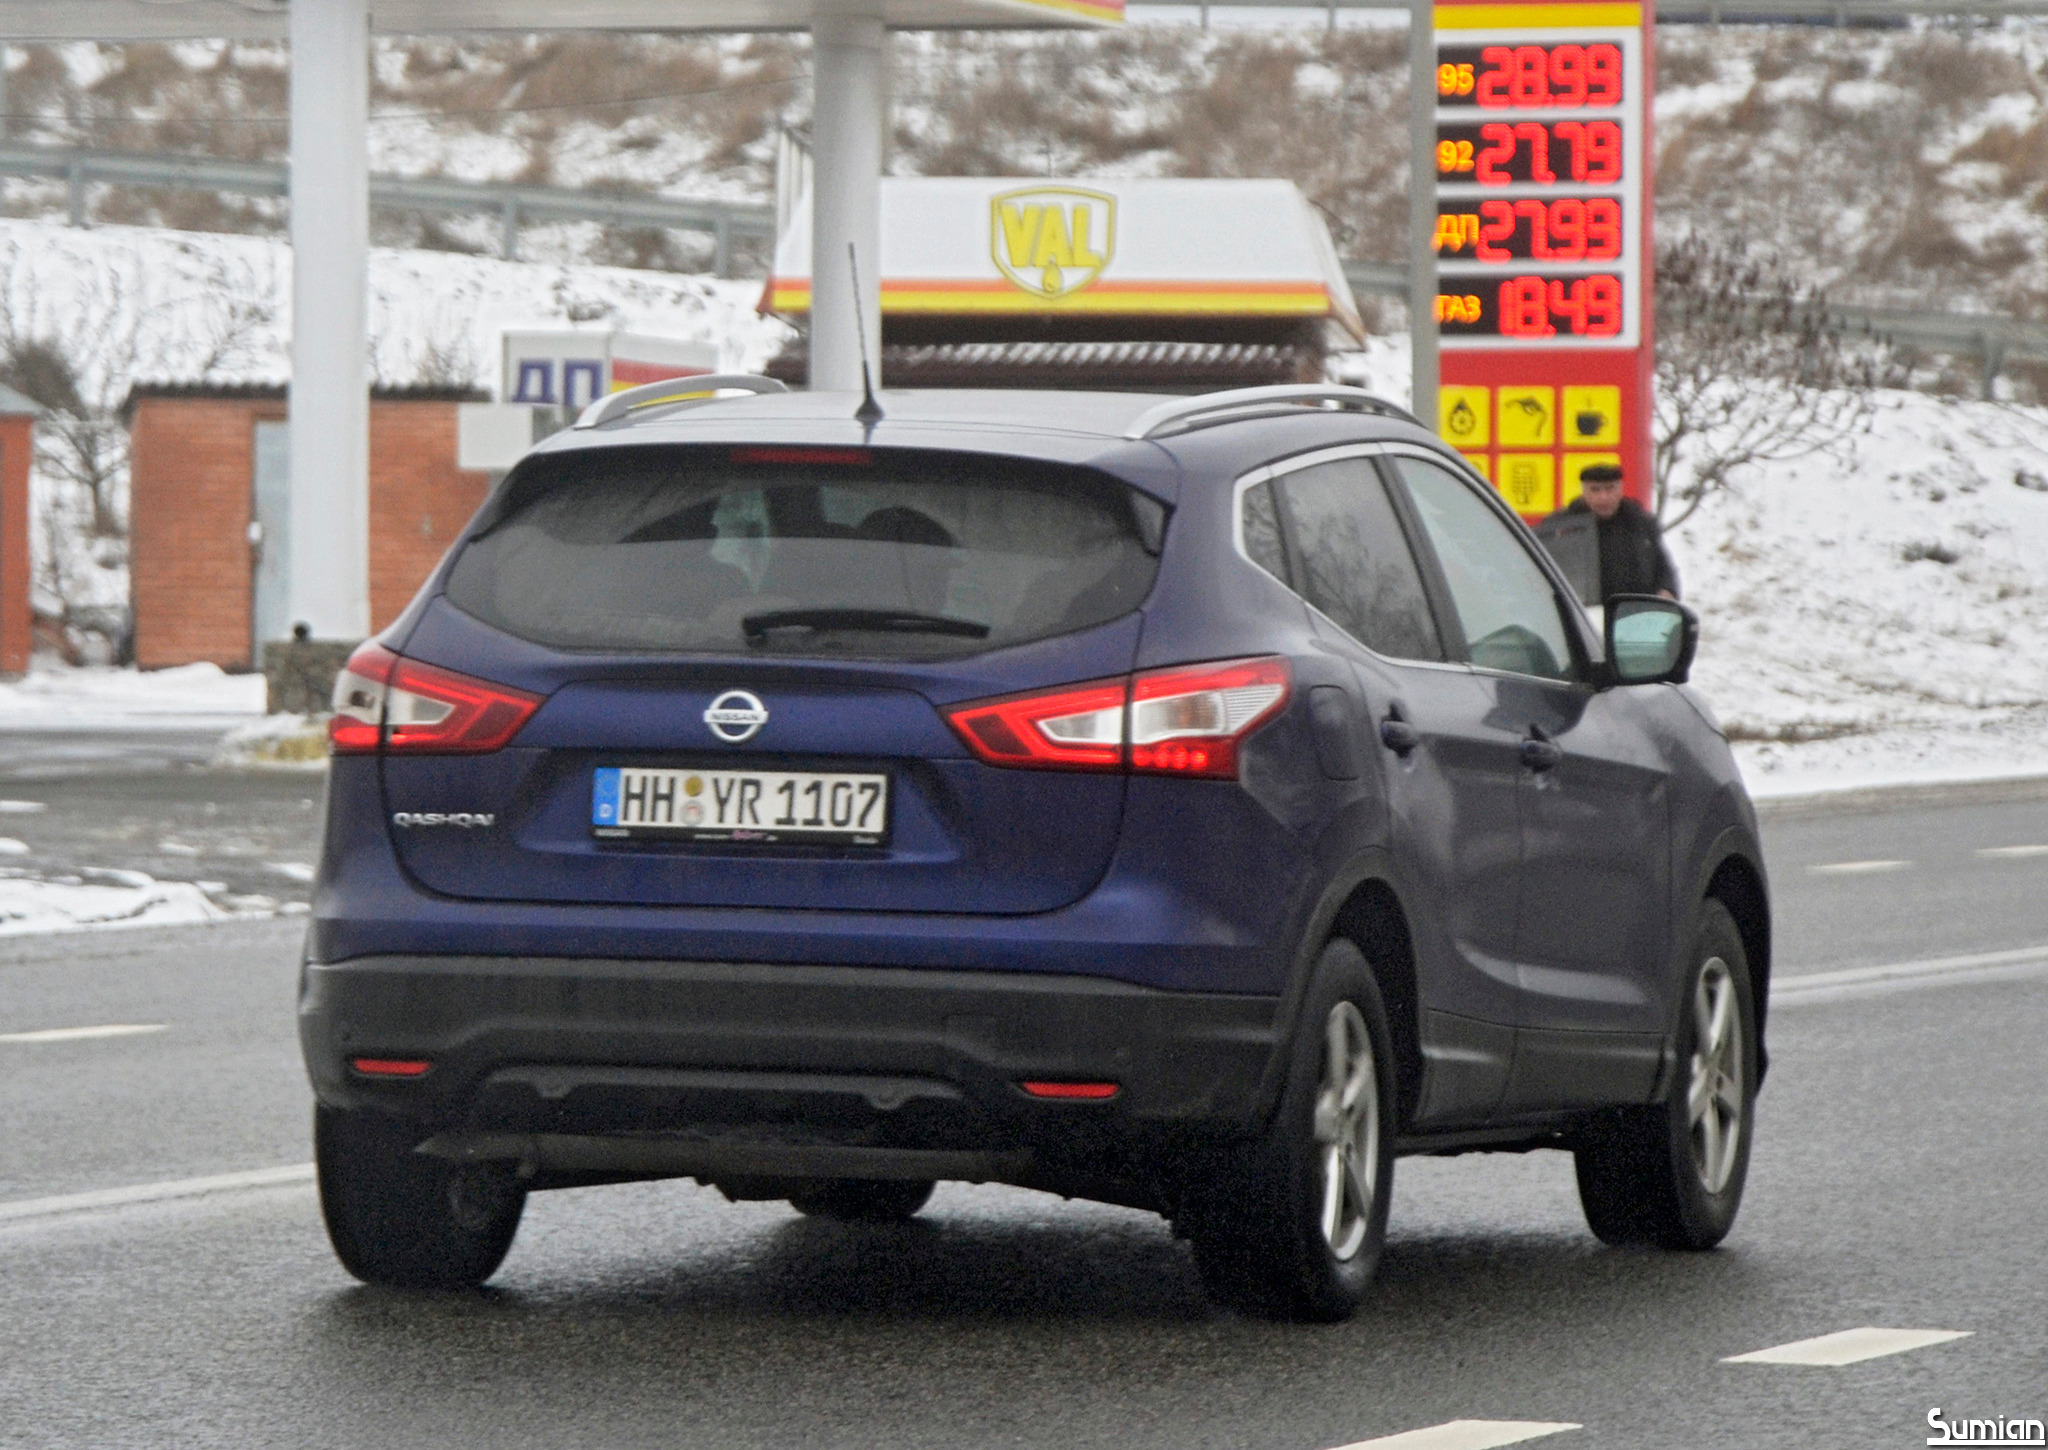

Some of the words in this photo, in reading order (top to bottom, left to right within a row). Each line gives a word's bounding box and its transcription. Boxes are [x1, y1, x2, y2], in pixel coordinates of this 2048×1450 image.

[1437, 63, 1475, 96] 95
[1476, 44, 1622, 109] 28.99
[1437, 140, 1475, 172] 92
[1476, 121, 1622, 186] 27.79
[1001, 203, 1103, 268] VAL
[1432, 214, 1480, 252] ДП
[1476, 198, 1622, 263] 27.99
[1433, 295, 1482, 323] ГАЗ
[1499, 275, 1622, 338] 18.49
[512, 358, 604, 408] ДП
[622, 775, 676, 822] HH
[712, 777, 761, 825] YR
[775, 780, 881, 827] 1107
